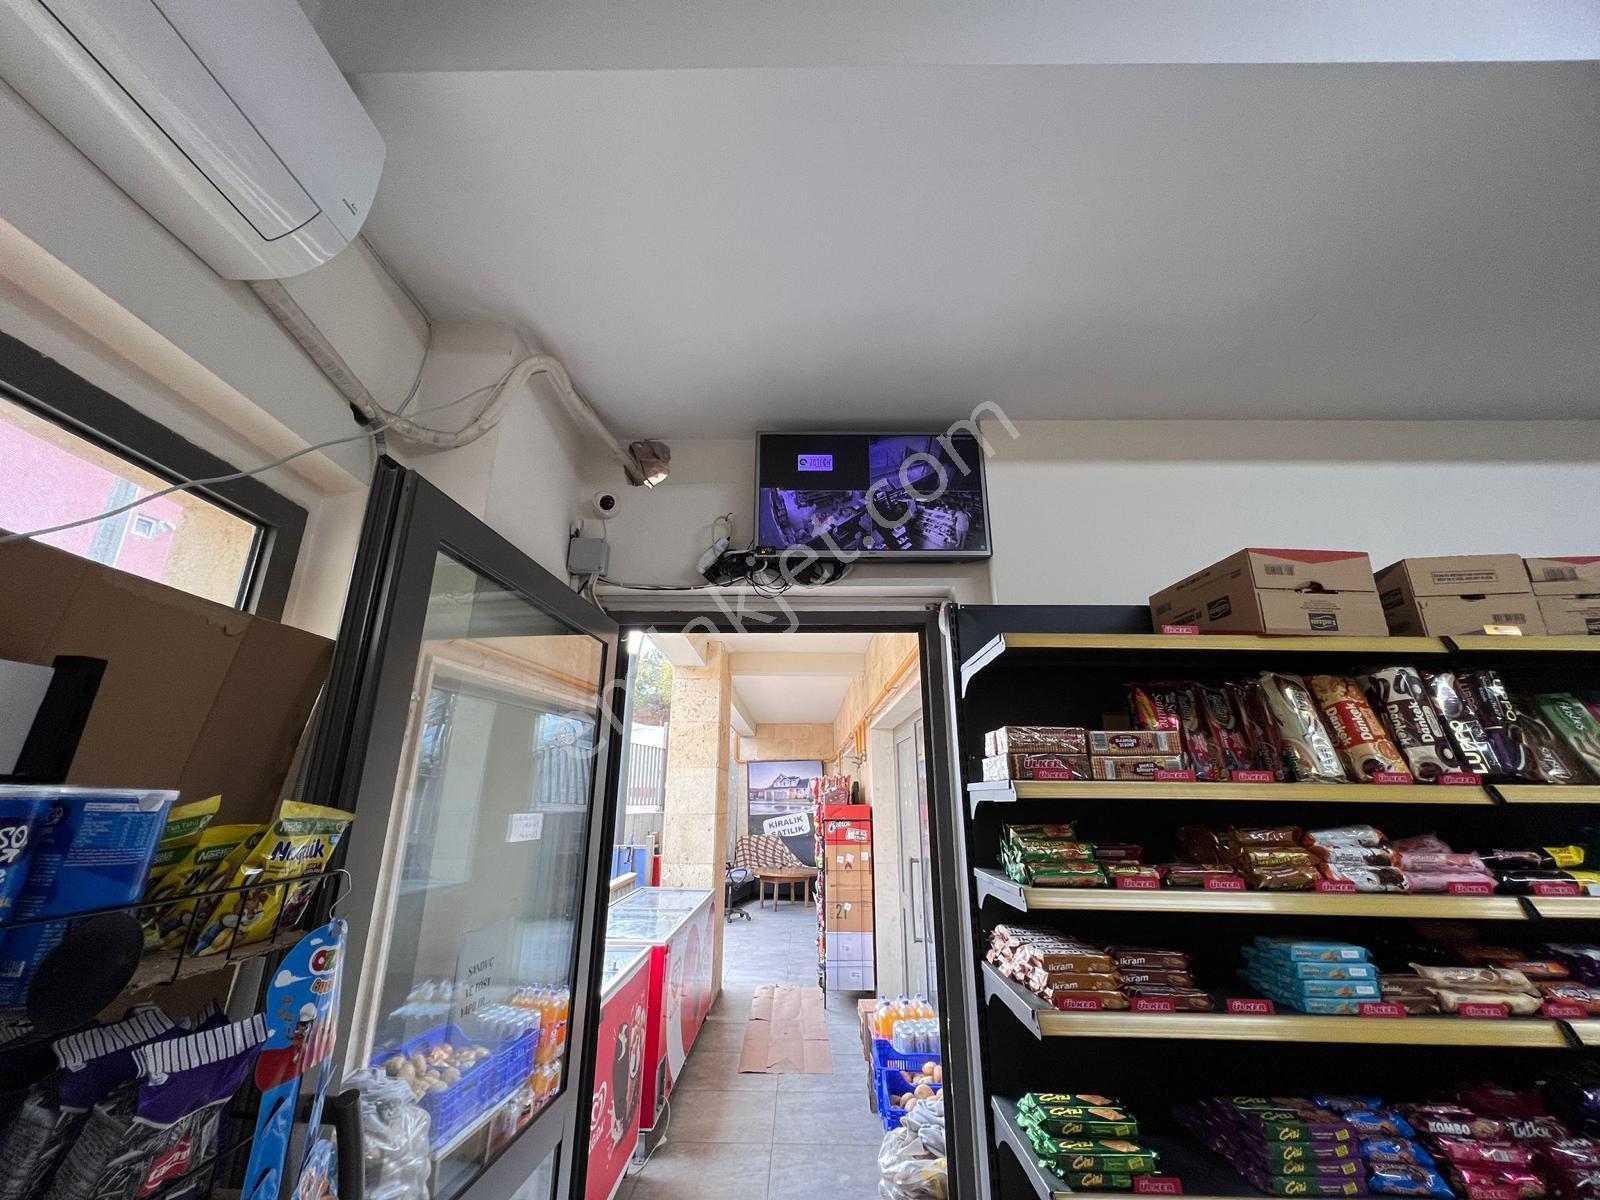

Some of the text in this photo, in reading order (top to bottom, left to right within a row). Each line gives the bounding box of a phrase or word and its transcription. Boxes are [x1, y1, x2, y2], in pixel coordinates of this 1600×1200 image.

[1326, 706, 1352, 746] Dankek
[1346, 702, 1374, 741] Dankek
[1408, 701, 1435, 744] Dankek
[1023, 757, 1063, 769] ÜLKER
[768, 815, 804, 829] KİRALIK
[771, 825, 805, 837] SATILIK
[1123, 877, 1156, 888] ÜLKER
[1063, 999, 1097, 1009] ÜLKER
[1137, 1000, 1171, 1011] ÜLKER
[1232, 1001, 1266, 1012] ÜLKER
[1363, 1004, 1398, 1015] ÜLKER
[1427, 1120, 1471, 1135] KOMBO
[1508, 1120, 1552, 1138] Tutku
